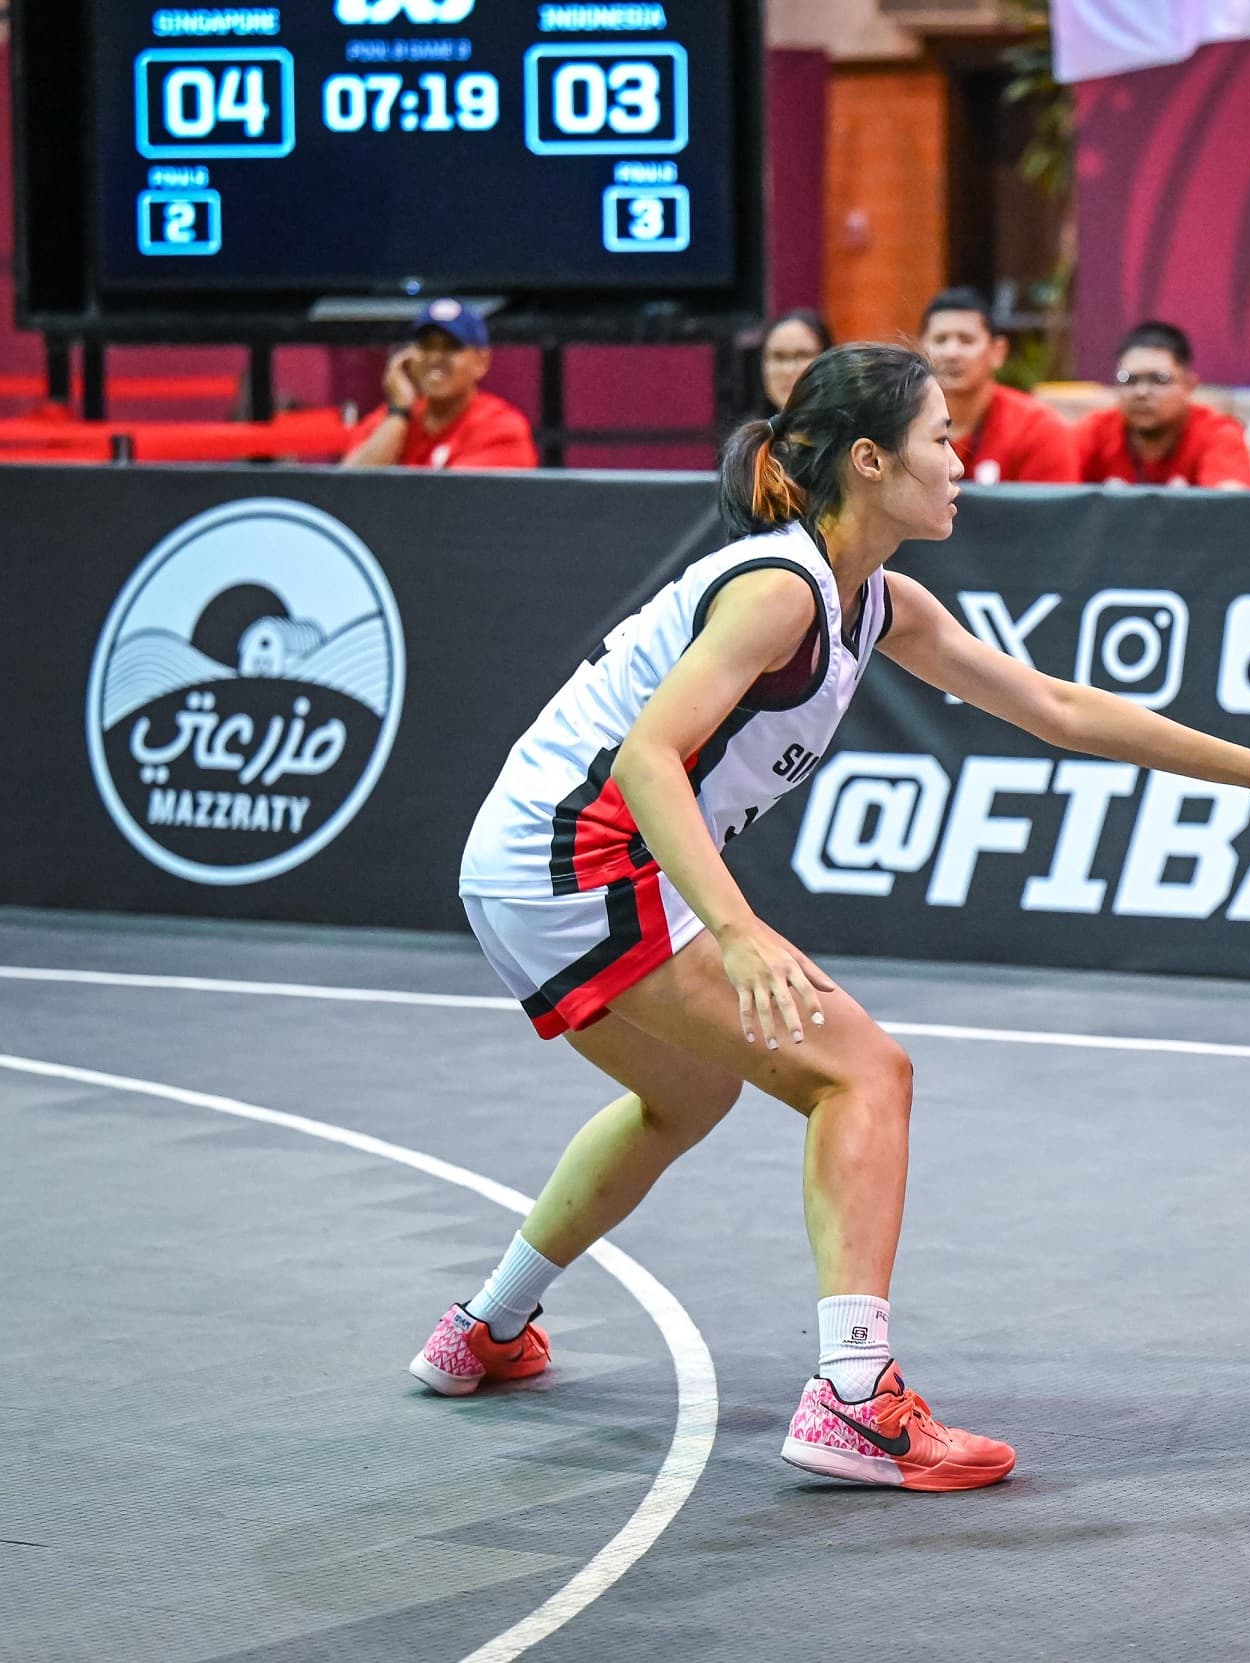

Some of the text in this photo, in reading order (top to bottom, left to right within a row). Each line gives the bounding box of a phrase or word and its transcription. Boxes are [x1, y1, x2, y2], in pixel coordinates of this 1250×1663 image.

[163, 66, 270, 138] 04
[322, 72, 500, 132] 07:19
[552, 62, 660, 134] 03
[164, 200, 197, 243] 2
[628, 197, 664, 240] 3
[148, 788, 311, 835] MAZZRATY
